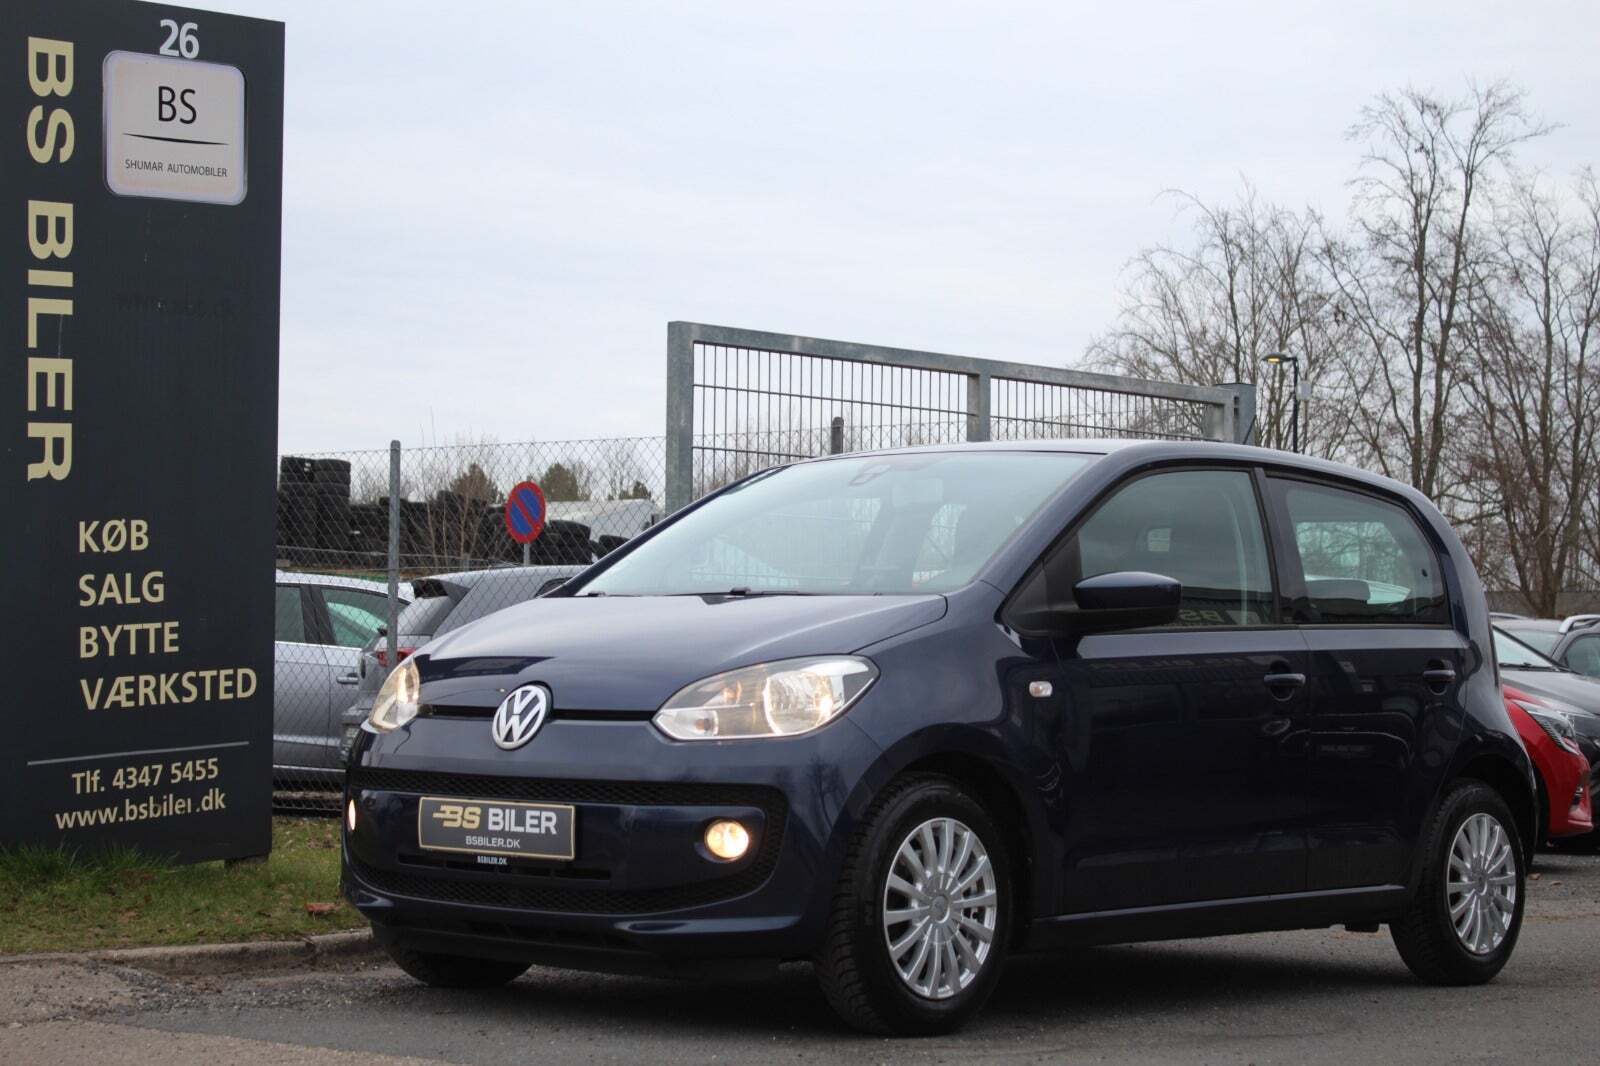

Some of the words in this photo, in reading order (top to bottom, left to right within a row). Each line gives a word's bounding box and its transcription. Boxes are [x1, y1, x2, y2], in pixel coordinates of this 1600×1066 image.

[159, 18, 200, 59] 26
[26, 36, 75, 165] BS
[157, 85, 198, 125] BS
[125, 158, 164, 172] SHUMAR
[167, 163, 228, 177] AUTOMOBILER
[26, 200, 74, 482] BILER
[78, 518, 149, 553] KØB
[78, 570, 165, 607] SALG
[79, 620, 180, 659] BYTTE
[79, 667, 257, 711] VÆRKSTED
[71, 769, 106, 795] Tlf.
[112, 763, 163, 790] 4347
[170, 757, 219, 784] 5455
[432, 804, 482, 830] BS
[487, 806, 558, 836] BILER
[465, 835, 521, 850] BSBILER.DK
